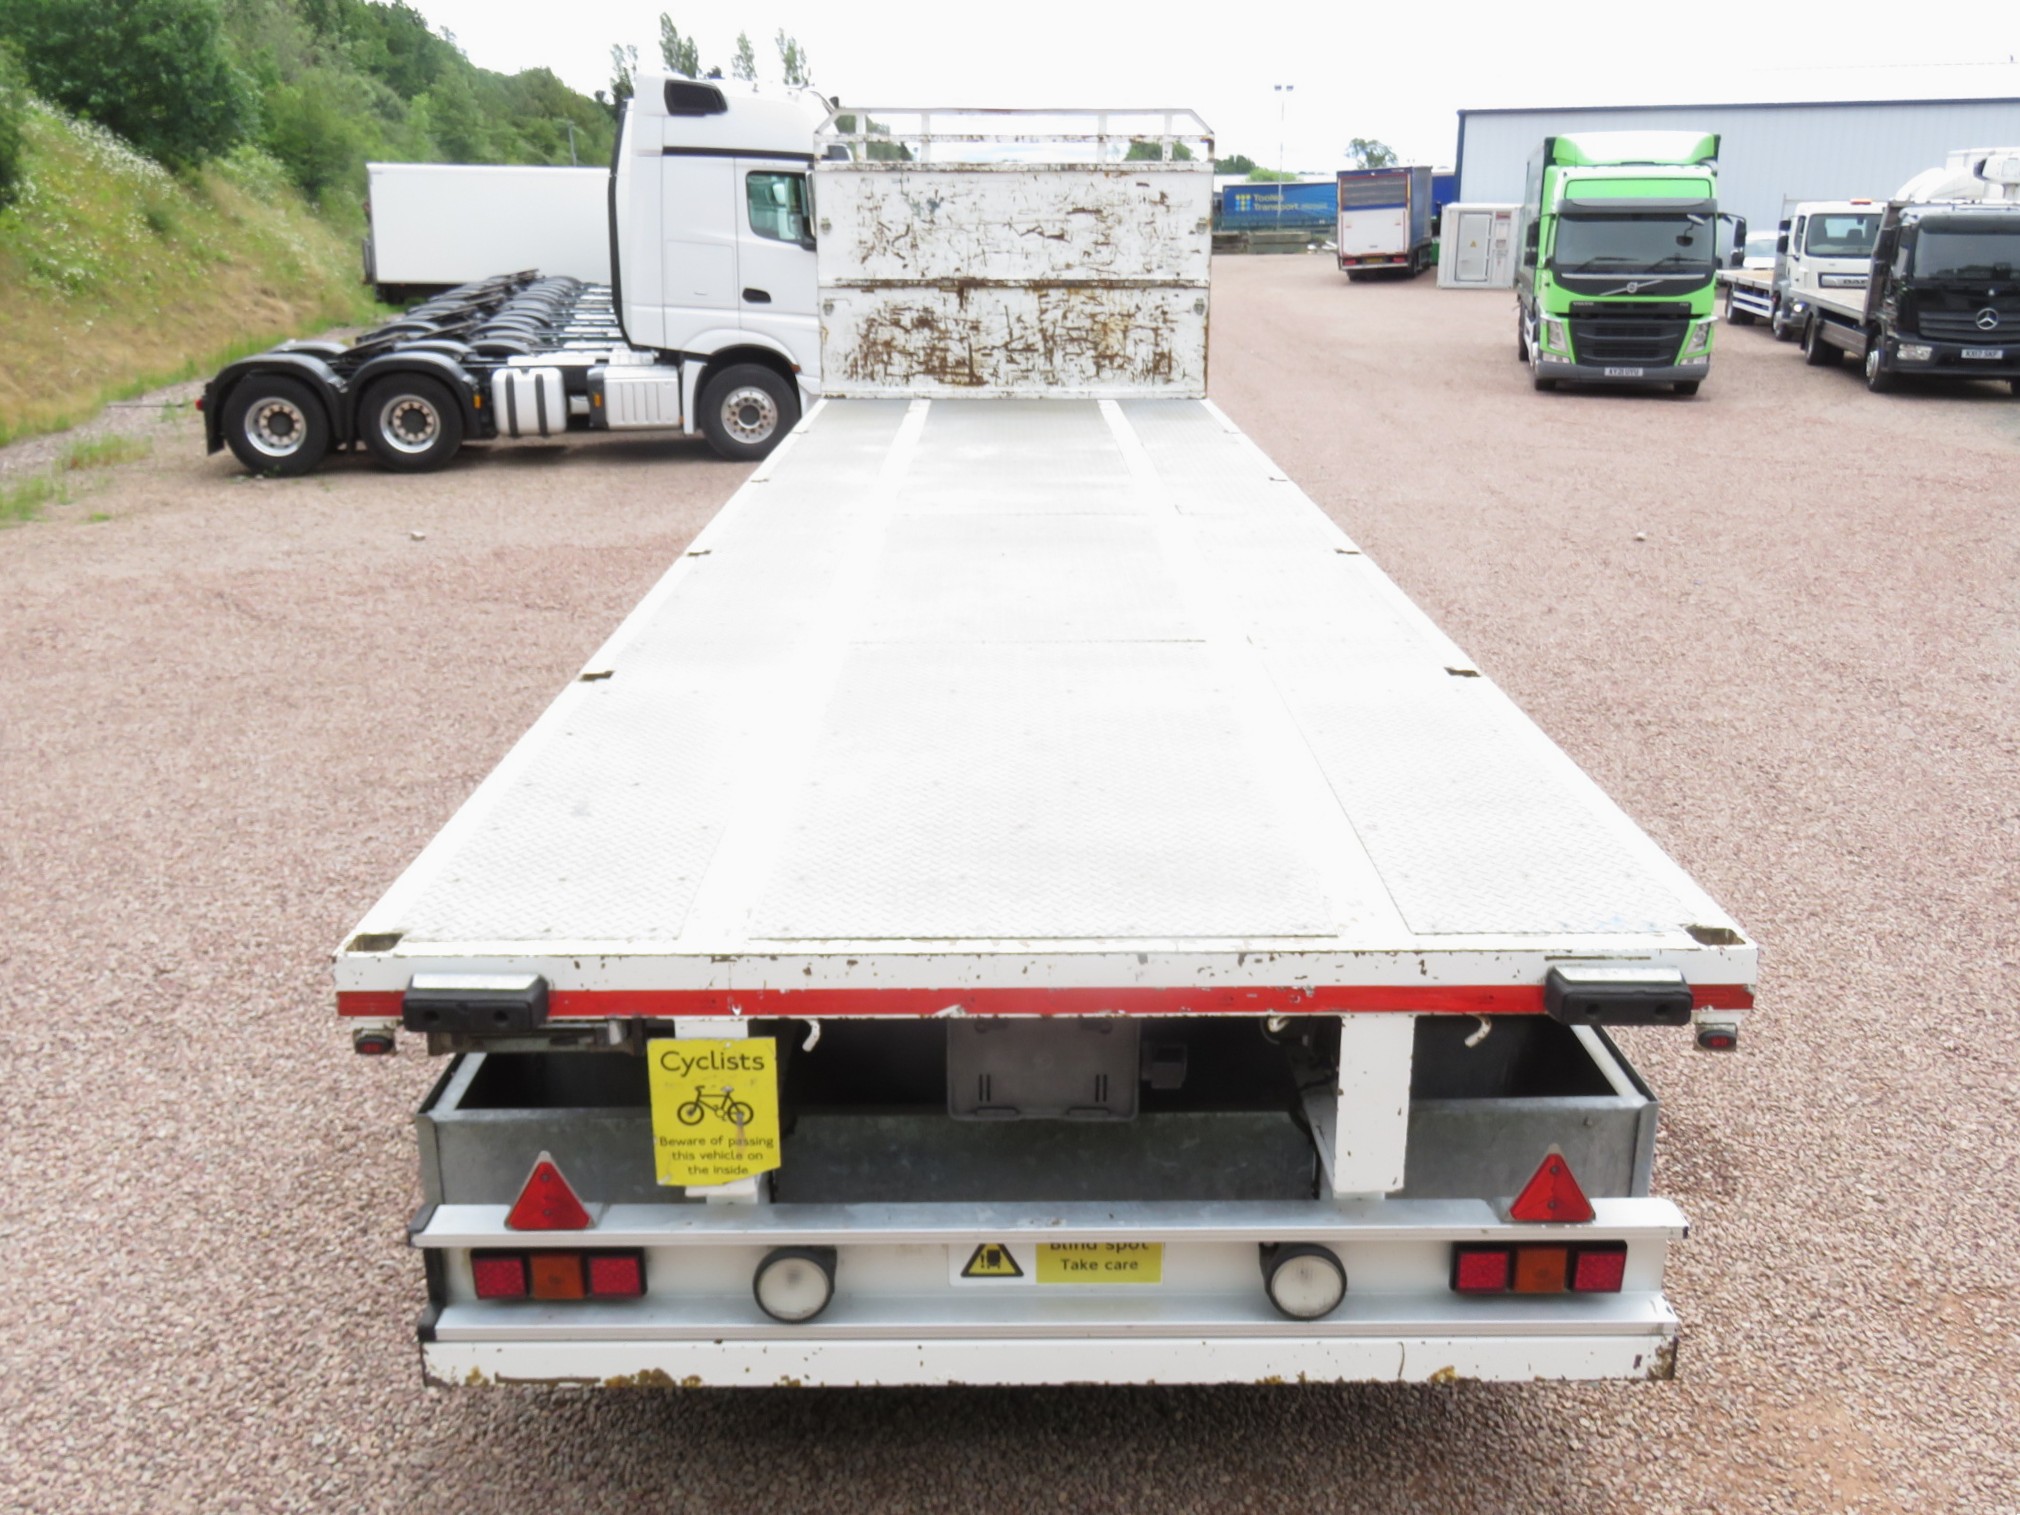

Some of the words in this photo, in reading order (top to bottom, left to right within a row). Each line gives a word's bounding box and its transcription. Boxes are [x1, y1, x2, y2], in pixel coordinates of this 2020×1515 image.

[660, 1050, 765, 1078] Cyclists
[659, 1136, 706, 1147] Beware
[710, 1135, 724, 1146] of
[728, 1136, 774, 1149] passing
[672, 1150, 695, 1160] this
[699, 1150, 743, 1161] vehicle
[747, 1151, 763, 1160] on
[688, 1164, 709, 1175] the
[1061, 1258, 1098, 1271] Take
[1104, 1260, 1139, 1271] care
